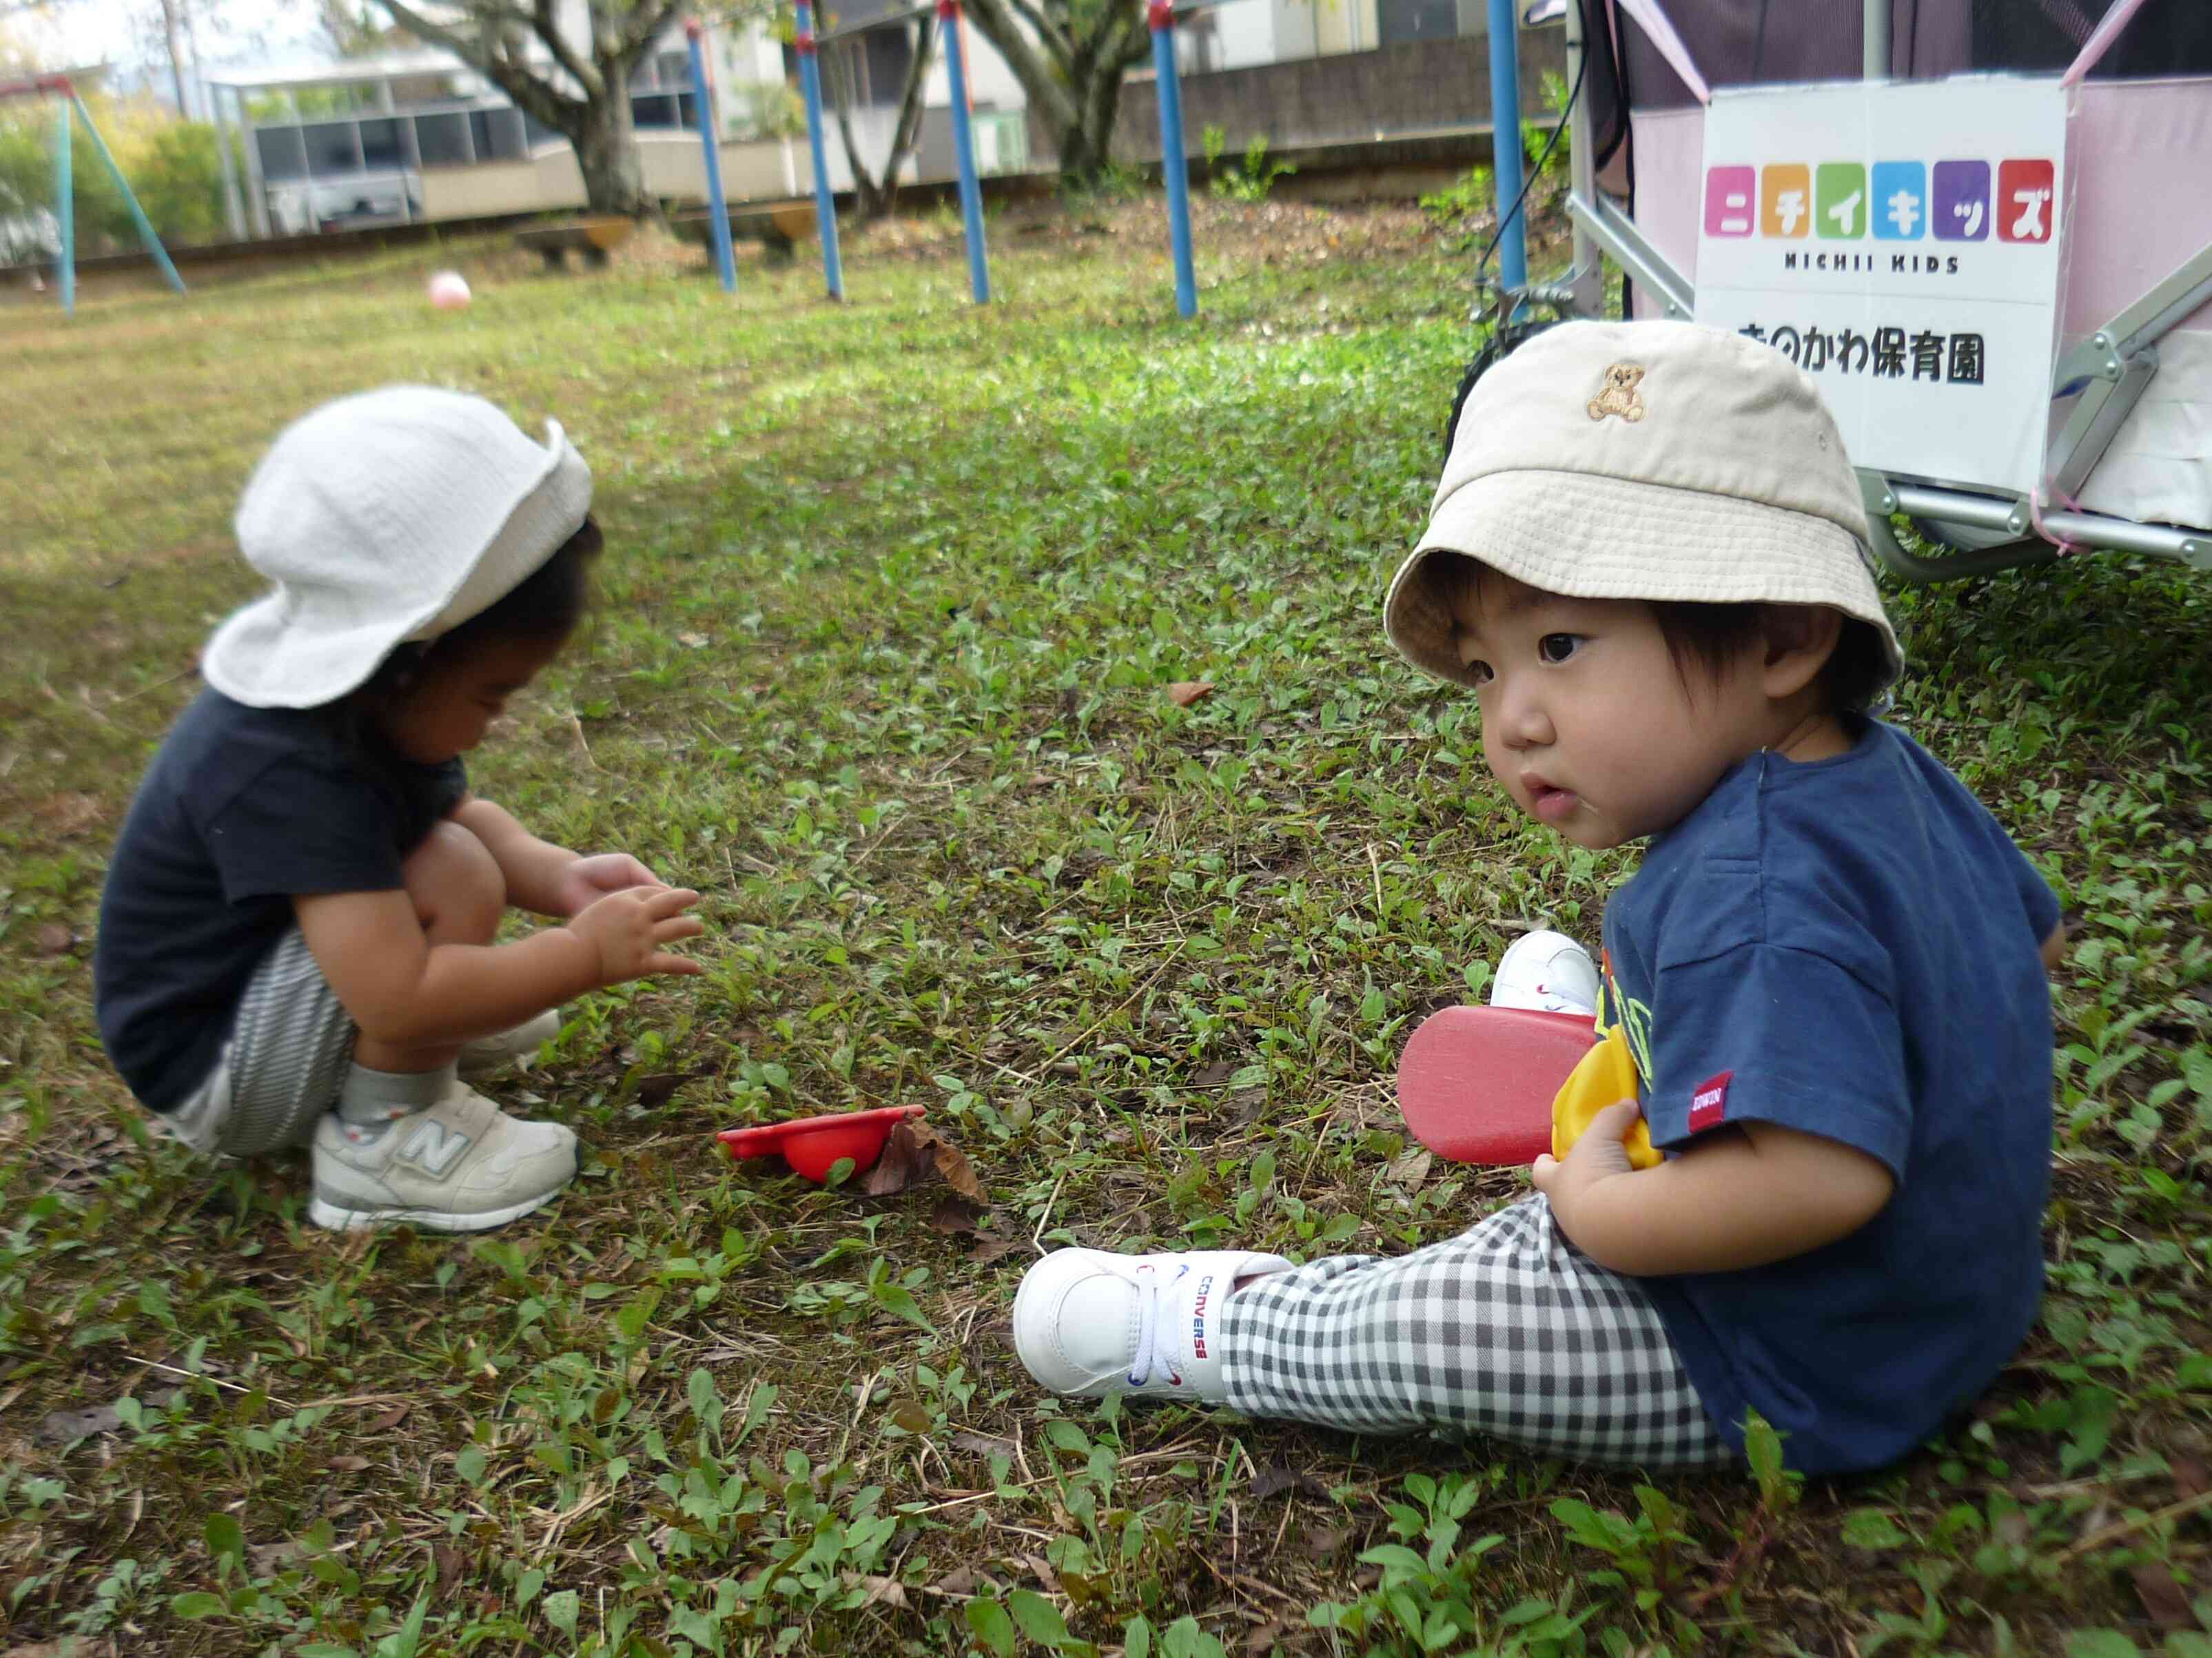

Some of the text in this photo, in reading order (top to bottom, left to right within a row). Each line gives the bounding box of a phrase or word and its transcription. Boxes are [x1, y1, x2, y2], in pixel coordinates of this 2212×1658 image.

[1721, 188, 2051, 240] ニチイキッズ
[1892, 254, 1958, 275] KIDS
[1692, 1087, 1722, 1112] EDWIN
[398, 1118, 471, 1174] N
[1194, 1275, 1214, 1360] CONVERSE
